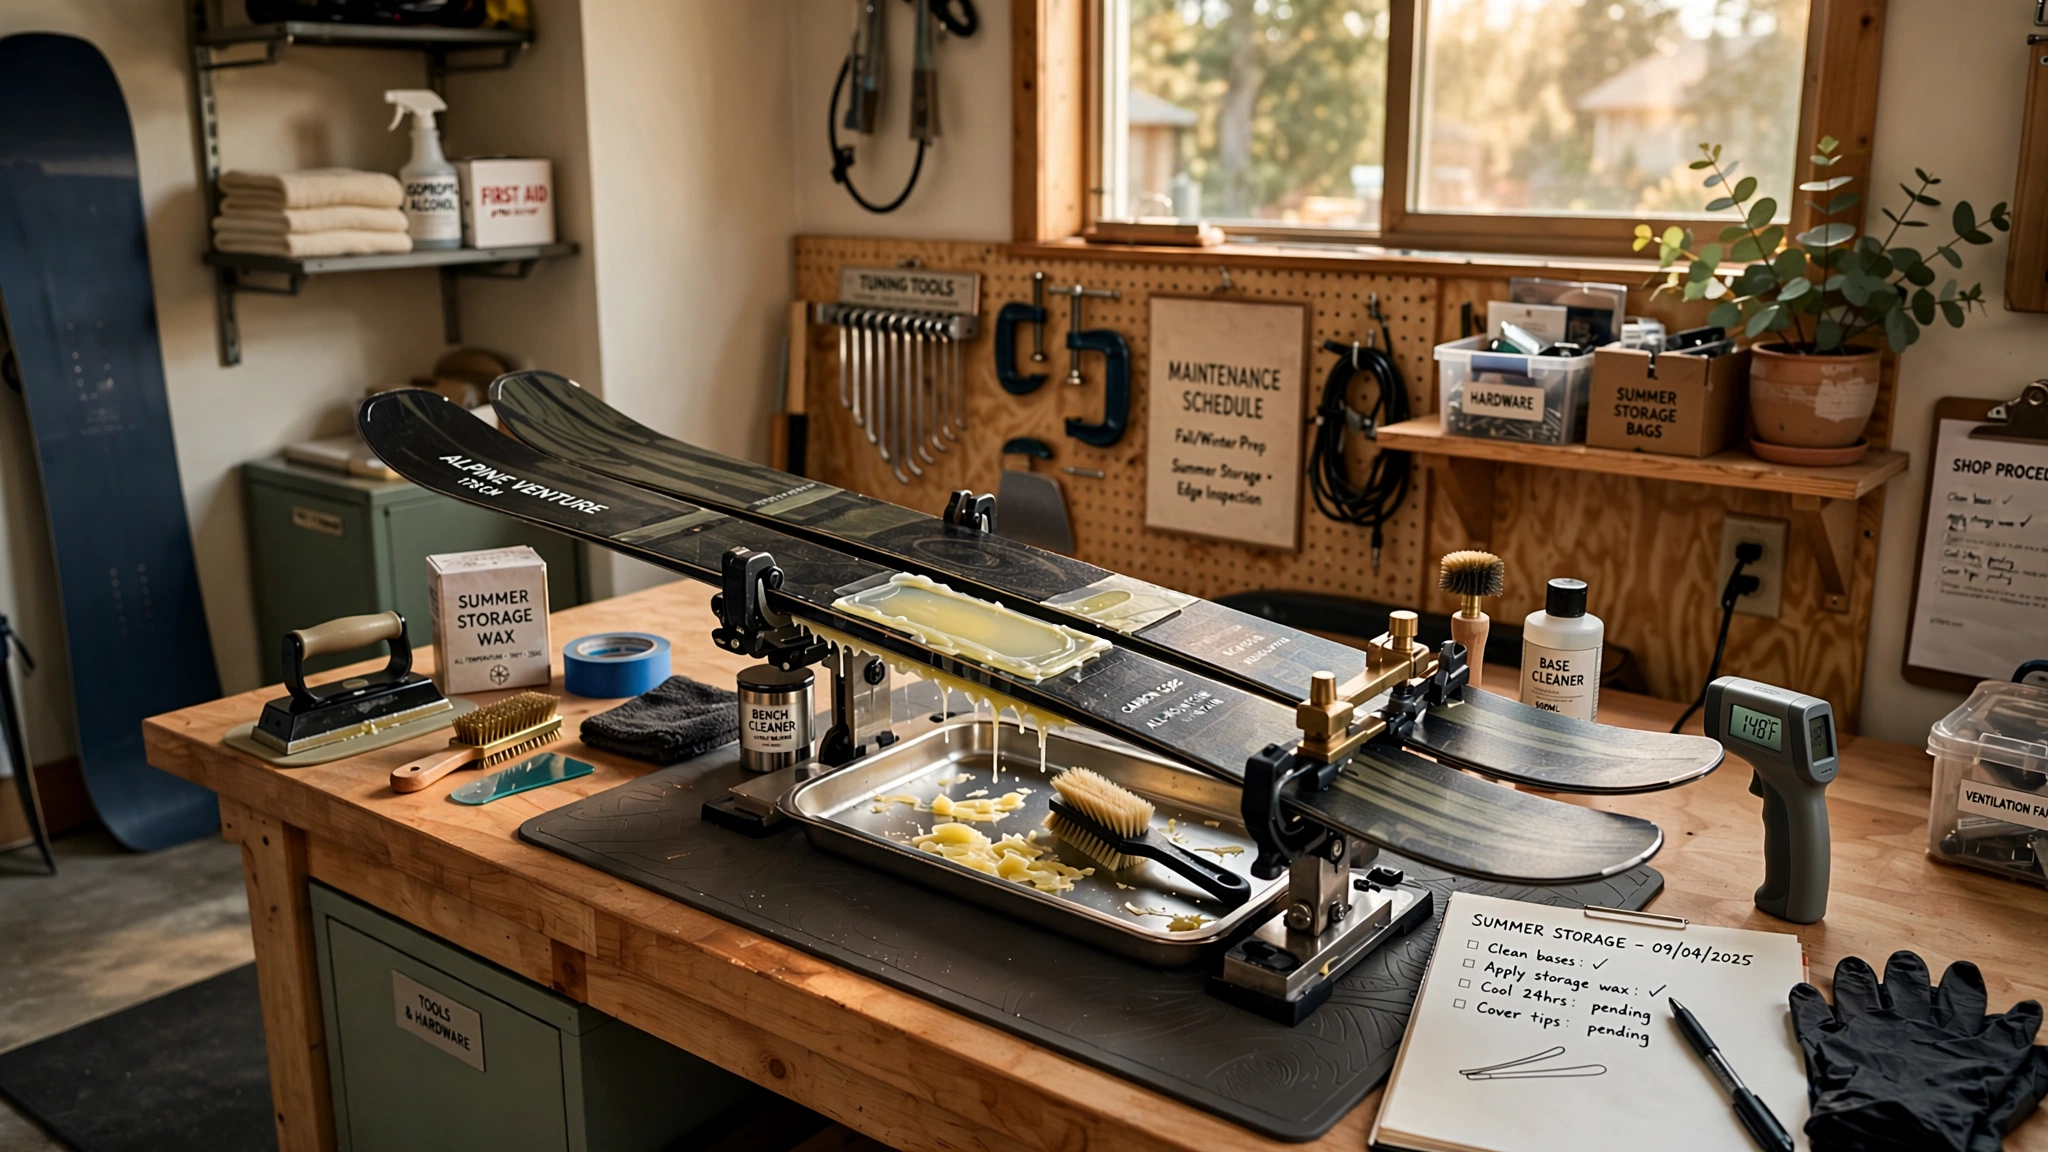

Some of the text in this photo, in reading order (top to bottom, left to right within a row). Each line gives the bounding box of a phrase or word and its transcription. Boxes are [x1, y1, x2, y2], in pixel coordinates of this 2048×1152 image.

[481, 184, 548, 205] FIRST AID
[859, 273, 955, 297] TUNING TOOLS
[1168, 360, 1282, 391] MAINTENANCE
[1182, 390, 1264, 419] SCHEDULE
[1470, 391, 1534, 411] HARDWARE
[1616, 387, 1678, 406] SUMMER
[1613, 403, 1678, 423] STORAGE
[1626, 421, 1664, 438] BAGS
[1175, 428, 1267, 457] Fall/Winter Prep
[1171, 458, 1262, 487] Summer Storage
[1952, 458, 1992, 475] SHOP
[439, 455, 610, 515] ALPINE VENTURE
[1177, 481, 1263, 507] Edge Inspection
[458, 589, 529, 609] SUMMER
[457, 608, 533, 629] STORAGE
[477, 629, 515, 647] WAX
[1540, 657, 1570, 672] BASE
[1532, 670, 1584, 687] CLEANER
[752, 708, 788, 720] BENCH
[748, 721, 796, 733] CLEANER
[1966, 790, 2031, 815] VENTILATION
[1471, 914, 1544, 937] SUMMER
[1553, 927, 1627, 949] STORAGE
[1652, 941, 1754, 966] 09/04/2025
[1488, 943, 1528, 960] Clean
[1484, 961, 1526, 983] Apply
[1534, 970, 1590, 992] storage
[418, 993, 451, 1022] TOOLS
[1480, 980, 1513, 997] Cool
[1591, 1002, 1651, 1026] pending
[415, 1010, 471, 1052] HARDWARE
[1476, 1001, 1522, 1020] Cover
[1587, 1023, 1650, 1048] pending
